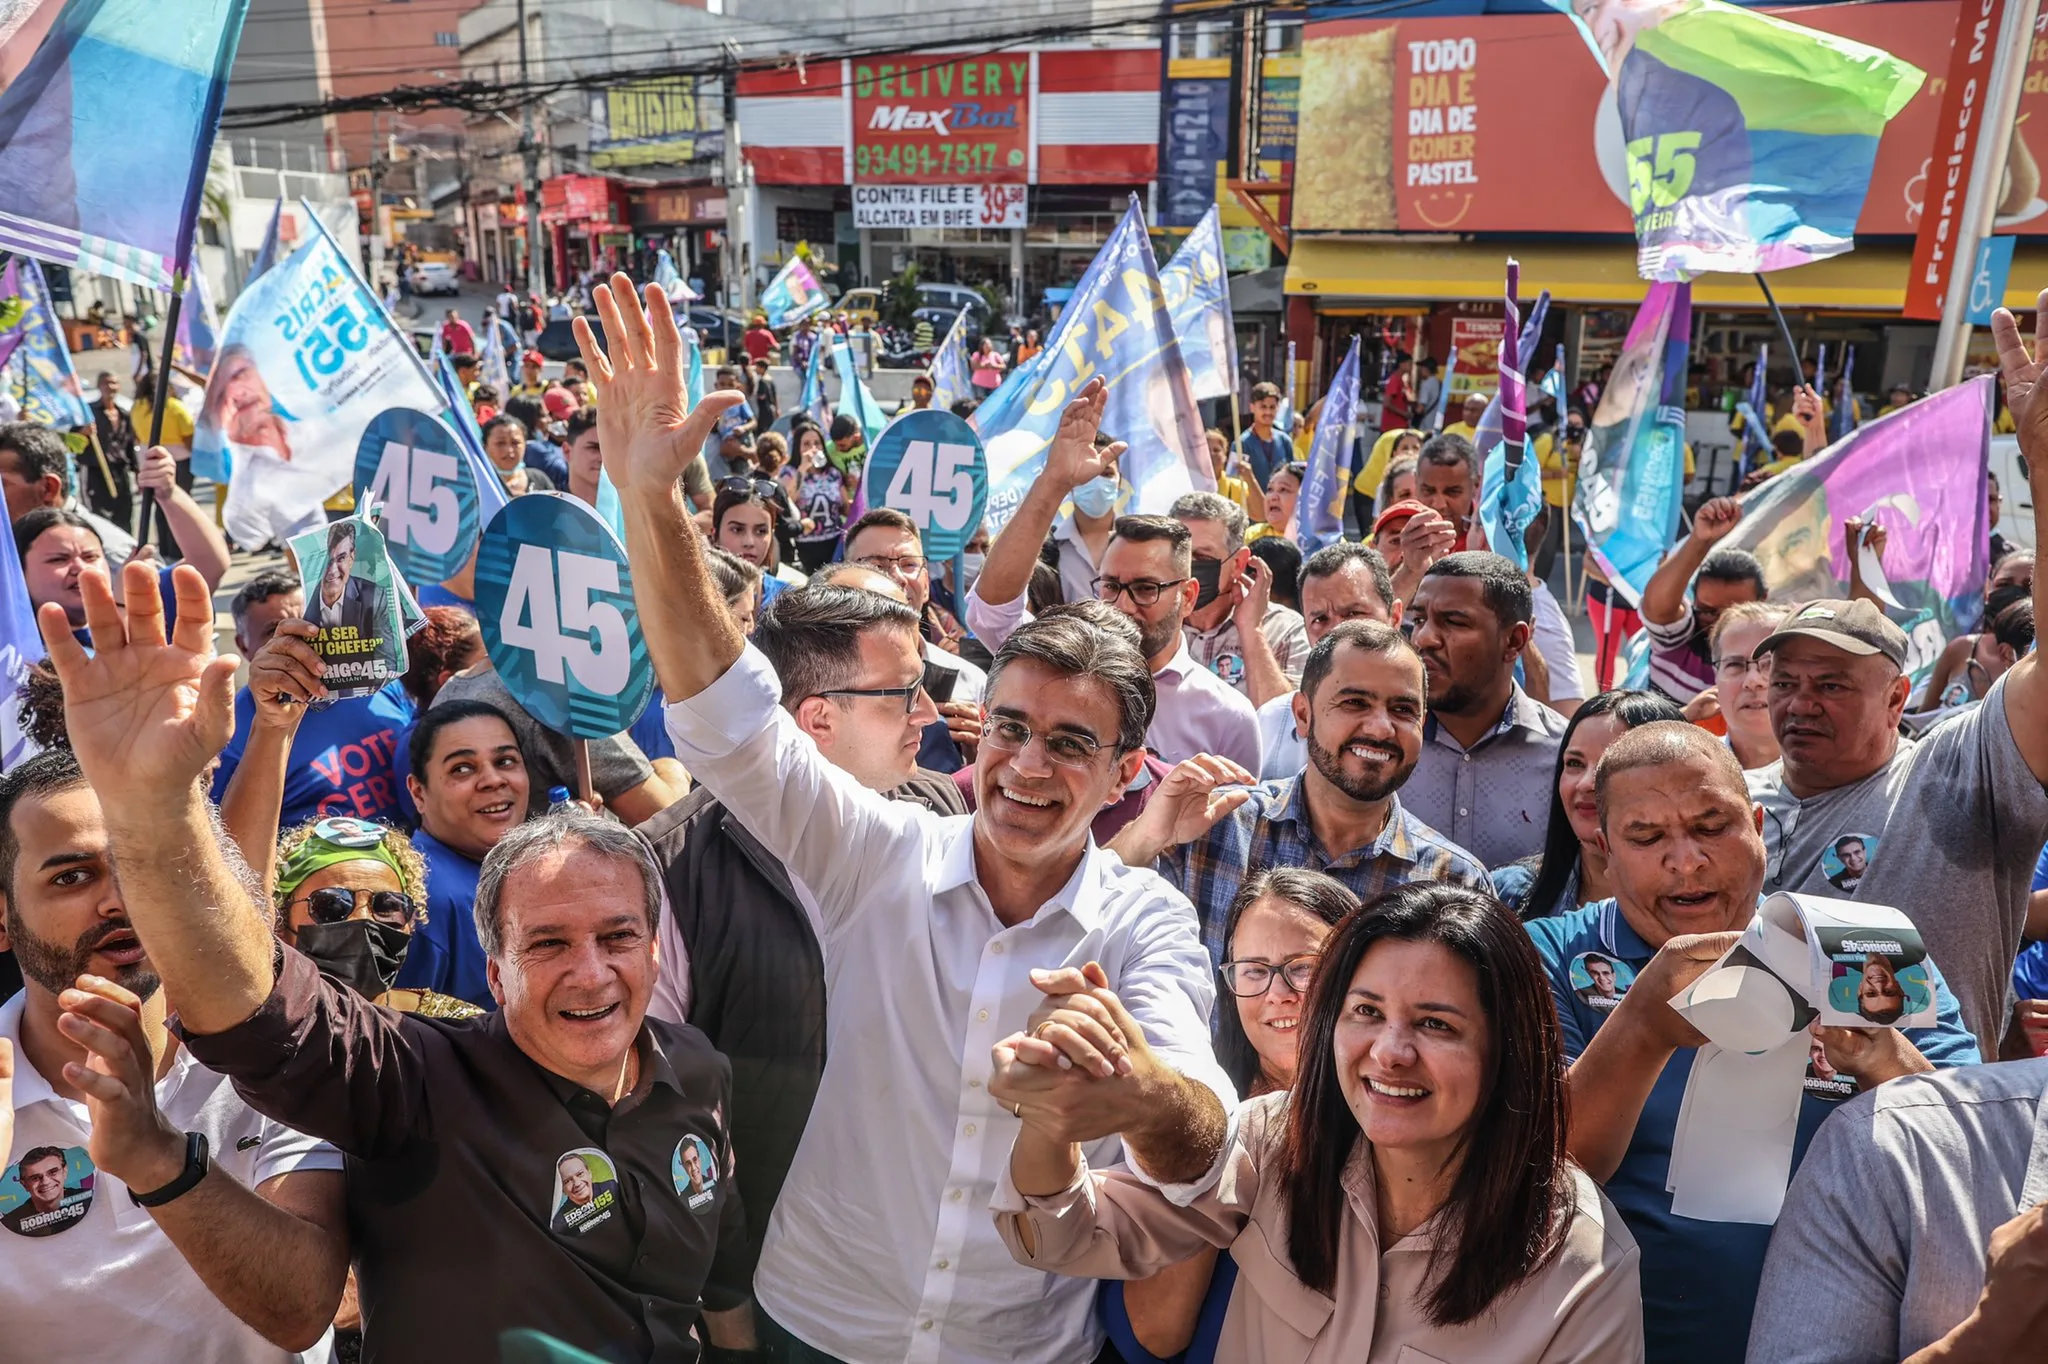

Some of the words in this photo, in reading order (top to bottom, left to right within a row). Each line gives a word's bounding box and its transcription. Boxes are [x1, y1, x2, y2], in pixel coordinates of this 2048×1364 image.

[1408, 37, 1477, 73] TODO
[856, 61, 1027, 98] DELIVERY
[1409, 74, 1451, 107] DIA
[1408, 108, 1443, 135] DIA
[1447, 105, 1478, 133] DE
[856, 143, 998, 176] 93491-7517
[1408, 134, 1475, 161] COMER
[856, 188, 914, 203] CONTRA
[964, 187, 975, 203] E
[1925, 78, 1977, 284] Francisco
[857, 210, 915, 225] ALCATRA
[921, 209, 940, 224] EM
[944, 209, 973, 224] BIFE
[369, 441, 460, 555] 45
[885, 440, 976, 531] 45
[331, 626, 358, 640] SER
[500, 543, 631, 696] 45
[310, 728, 398, 788] VOTE
[20, 1202, 85, 1231] RODRIGO45
[564, 1201, 595, 1223] EDSON
